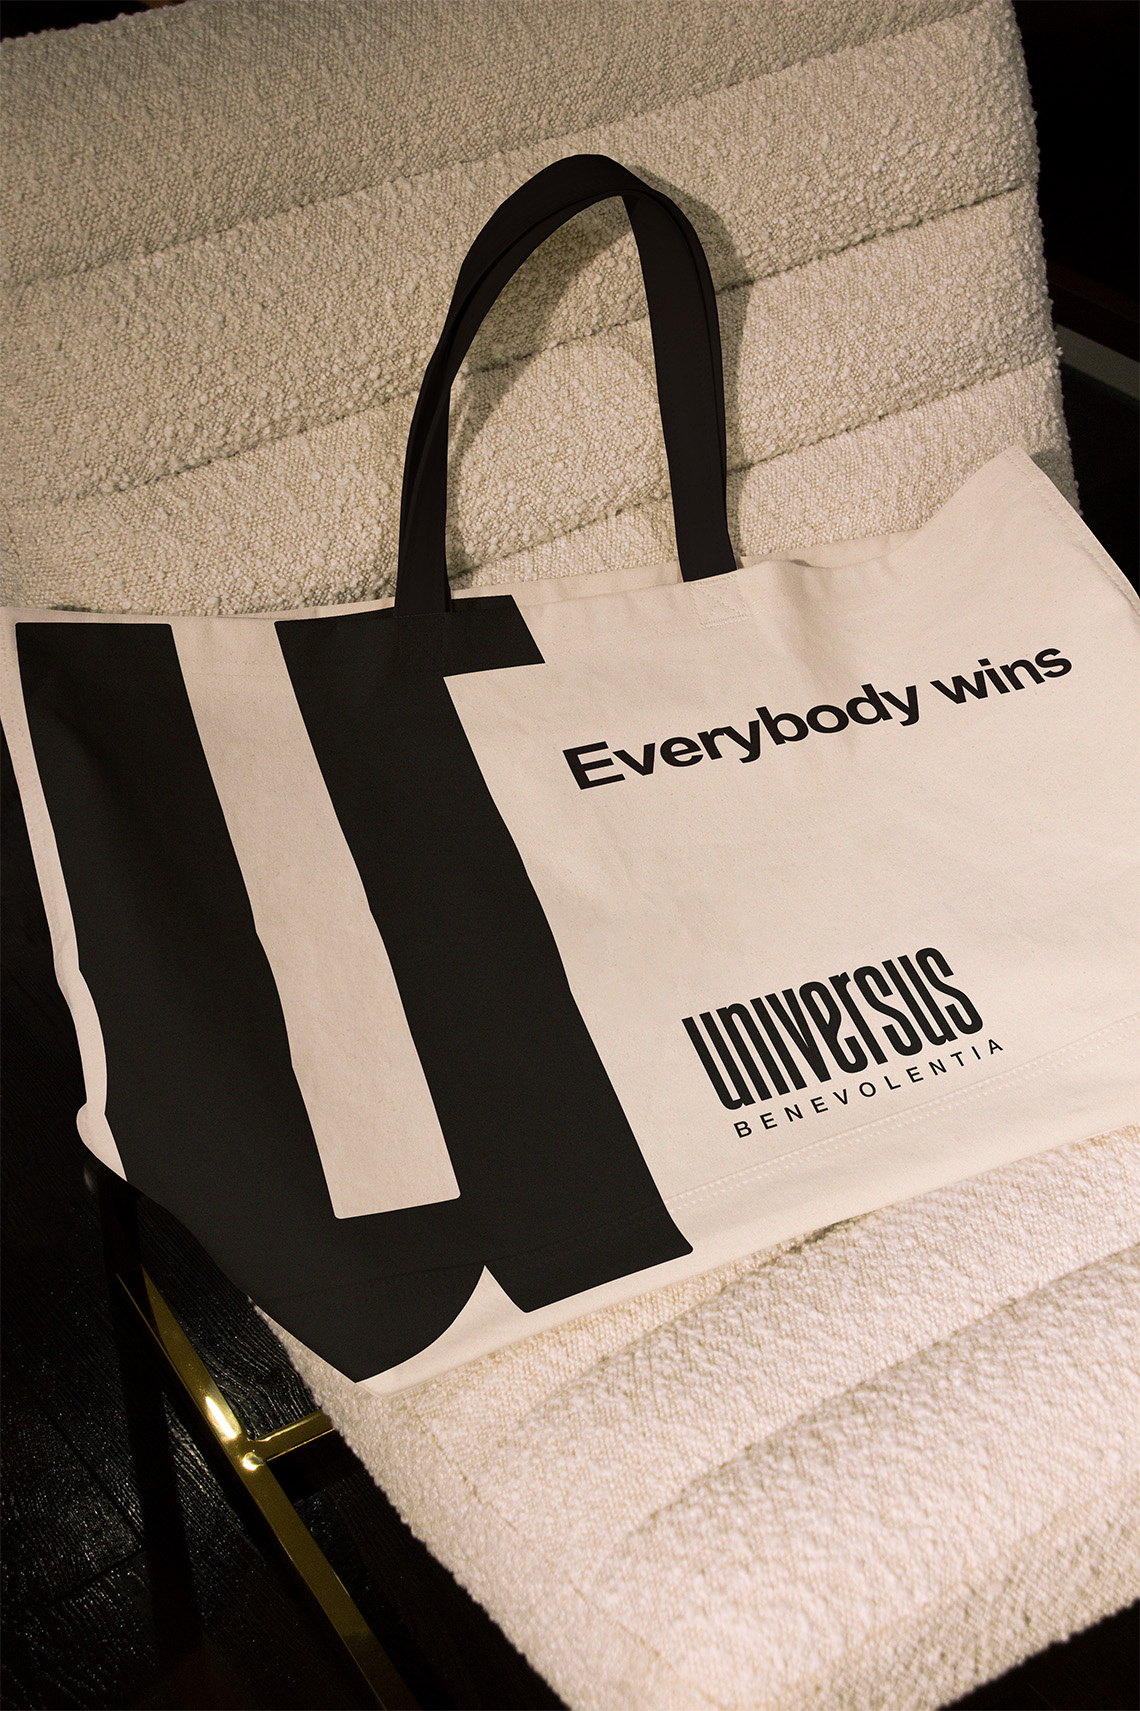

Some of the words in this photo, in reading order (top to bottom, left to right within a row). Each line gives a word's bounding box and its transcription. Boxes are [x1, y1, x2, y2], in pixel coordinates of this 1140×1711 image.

[562, 684, 919, 791] Everybody
[929, 646, 1074, 706] wins
[733, 1037, 1005, 1140] BENEVOLENTIA
